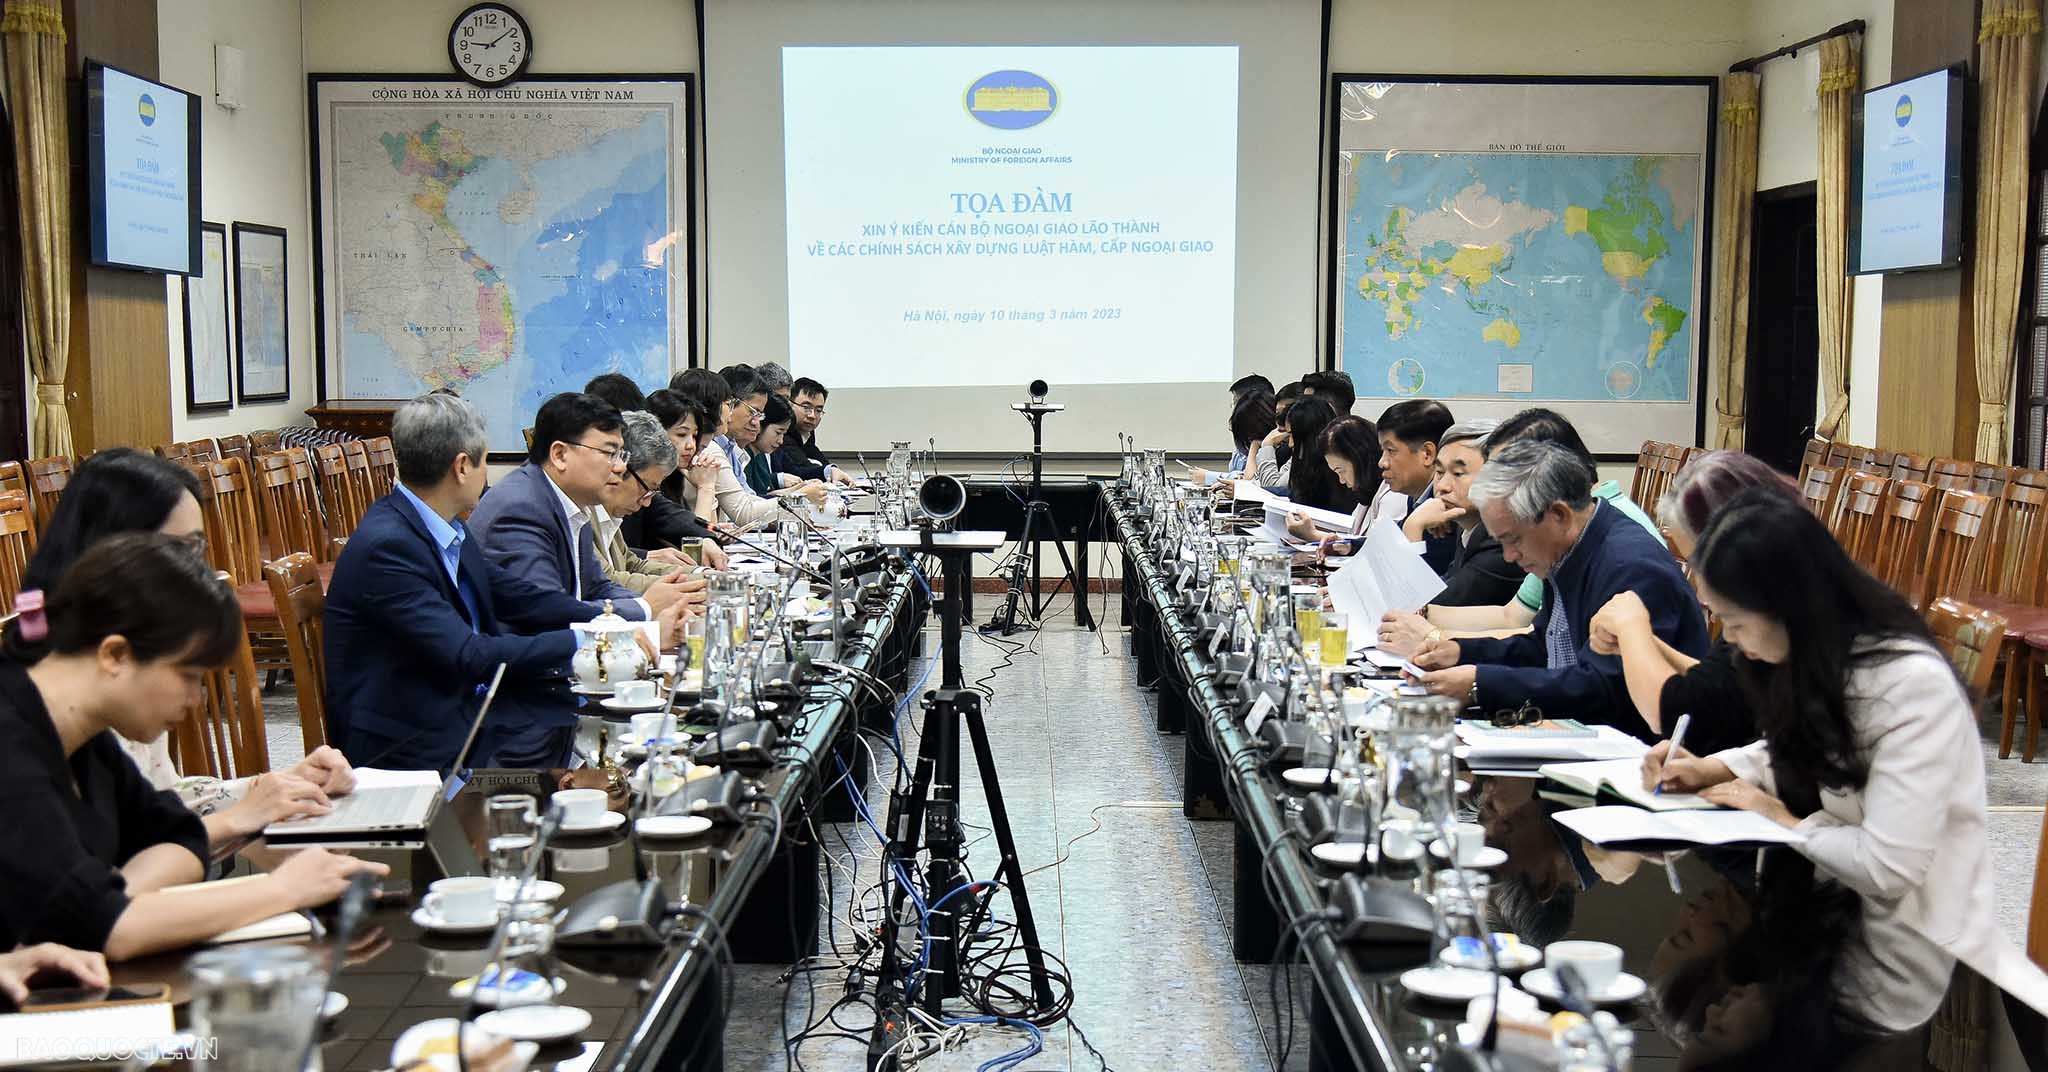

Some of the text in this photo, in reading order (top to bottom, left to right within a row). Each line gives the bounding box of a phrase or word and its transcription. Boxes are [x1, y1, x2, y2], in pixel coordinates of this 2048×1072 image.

[474, 16, 483, 27] 11
[485, 13, 497, 25] 12
[502, 17, 506, 28] 1
[463, 26, 475, 37] 10
[510, 27, 518, 39] 2
[460, 40, 468, 51] 9
[512, 41, 521, 52] 3
[463, 53, 472, 64] 8
[508, 54, 517, 65] 4
[473, 63, 482, 75] 7
[486, 67, 495, 78] 6
[499, 64, 508, 75] 5
[372, 86, 634, 101] CỘNG HÒA XÃ HỘI CHỦ NGHĨA VIỆT NAM
[982, 147, 994, 156] BỘ
[1022, 147, 1042, 155] GIAO
[952, 156, 1073, 165] MINISTRY OF FOREIGN AFFAIRS
[950, 186, 1073, 219] TỌA ĐÀM
[862, 224, 886, 236] XIN
[902, 220, 933, 236] KIẾN
[937, 221, 967, 236] CÁN
[970, 220, 990, 238] BỘ
[994, 223, 1039, 238] NGOẠI
[1043, 223, 1078, 234] GIAO
[1082, 219, 1109, 234] LÃO
[1112, 219, 1160, 233] THÀNH
[807, 240, 825, 257] VỀ
[828, 241, 855, 256] CÁC
[859, 241, 903, 255] CHÍNH
[906, 241, 942, 255] SÁCH
[946, 240, 972, 255] XÂY
[976, 242, 1018, 257] DỰNG
[1023, 239, 1056, 256] LUẬT
[1101, 237, 1127, 253] CẤP
[1131, 241, 1175, 255] NGOẠI
[1180, 240, 1214, 252] GIAO
[903, 309, 920, 321] Hà
[953, 310, 985, 324] ngày
[990, 309, 1005, 320] 10
[1049, 309, 1057, 320] 3
[1092, 308, 1122, 320] 2023
